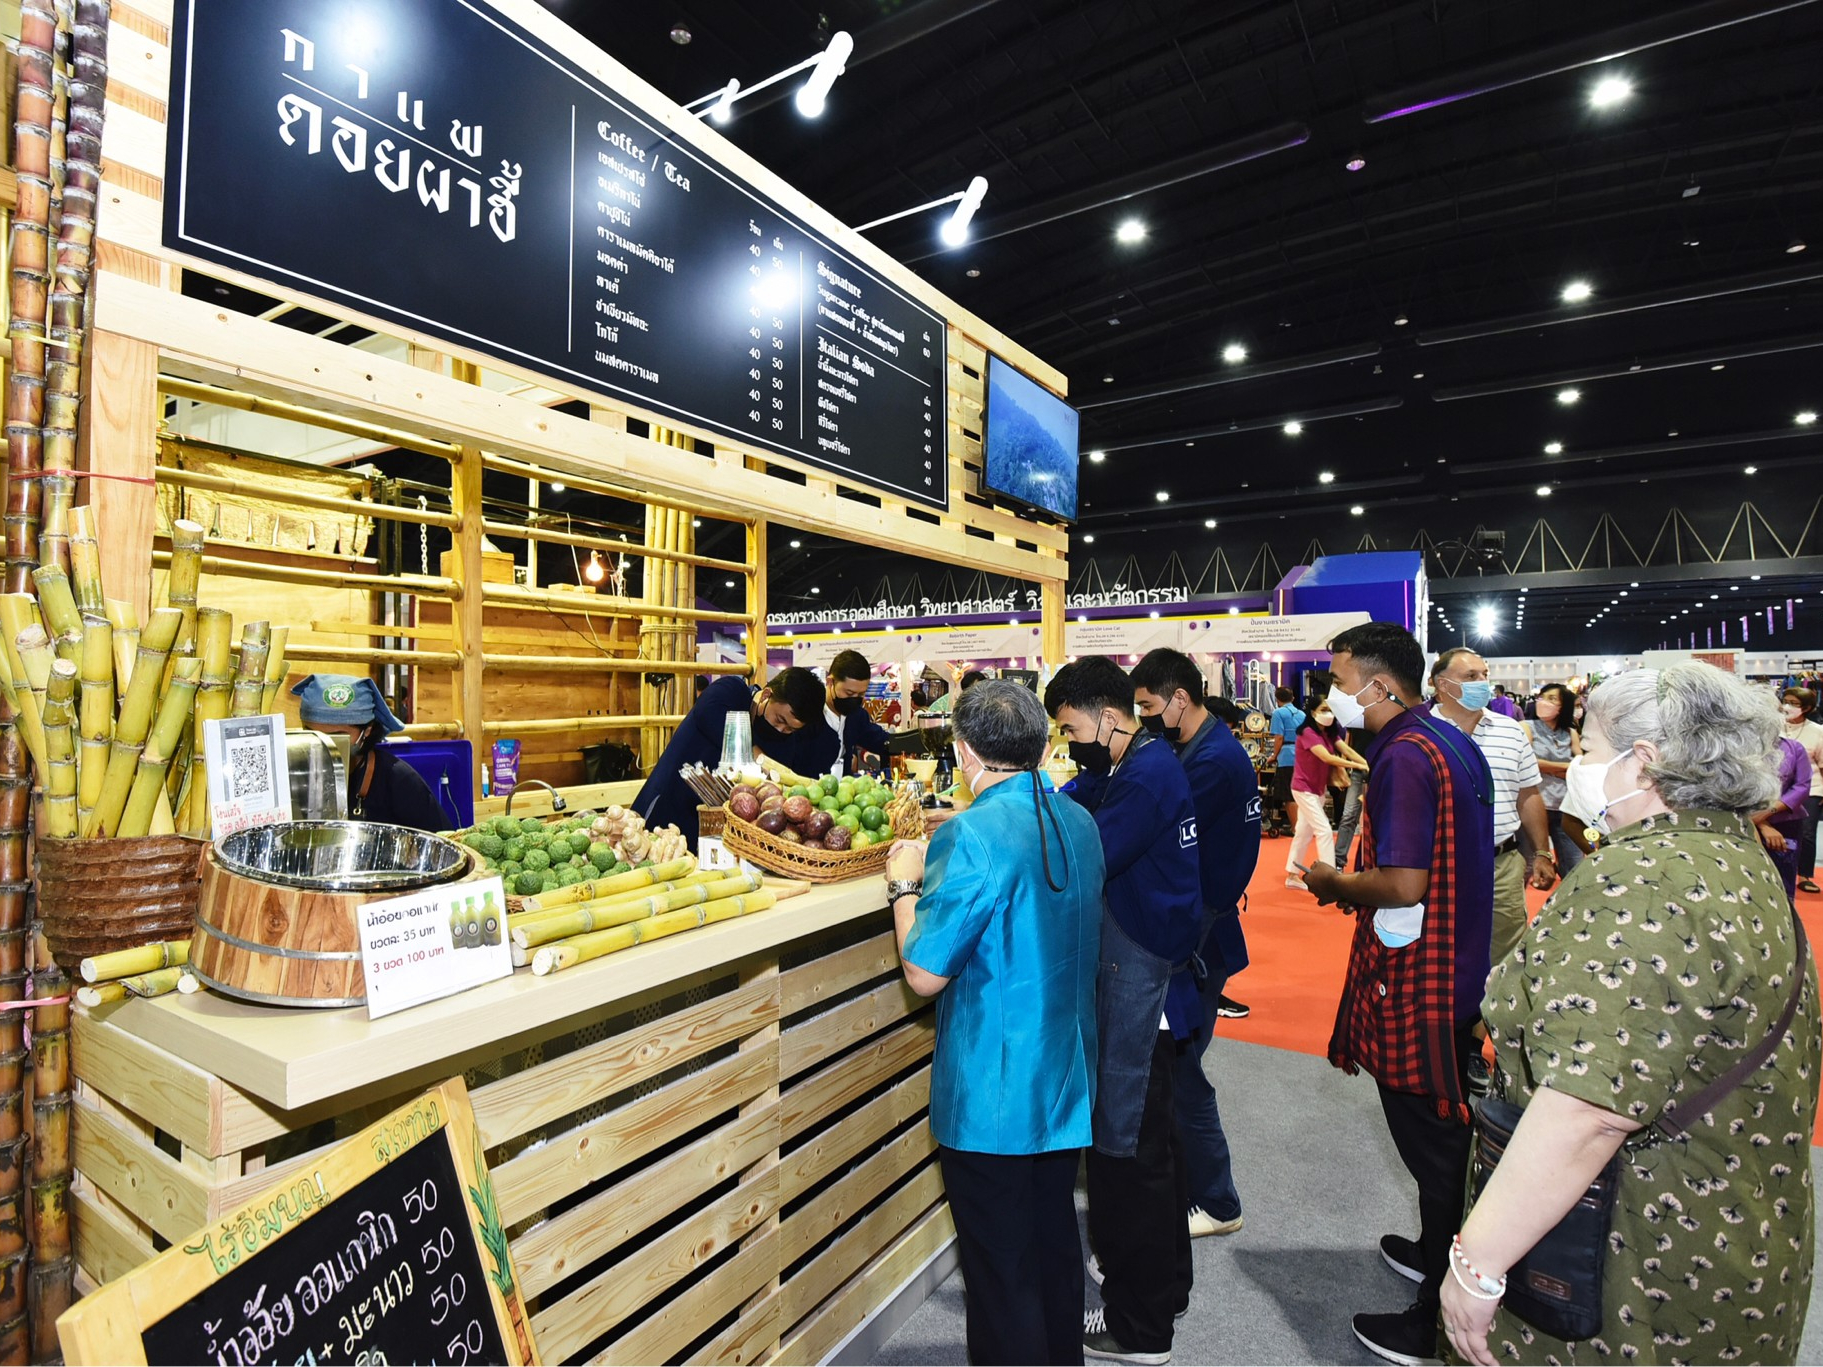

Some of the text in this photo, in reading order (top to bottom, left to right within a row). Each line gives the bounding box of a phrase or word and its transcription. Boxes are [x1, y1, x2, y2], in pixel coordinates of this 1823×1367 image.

[597, 120, 646, 163] Coffee
[664, 160, 691, 193] Tea
[749, 244, 783, 270] 40 50
[749, 264, 761, 277] 40
[817, 260, 862, 299] Signature
[596, 275, 620, 295] ลาเต้
[749, 306, 783, 330] 40 50
[850, 303, 871, 324] Coffee
[595, 322, 619, 343] โกโก้
[749, 327, 783, 350] 40 50
[749, 347, 783, 371] 40 50
[817, 336, 875, 378] Italian Soda
[749, 368, 783, 390] 40 50
[749, 389, 783, 411] 40 50
[749, 410, 783, 431] 40 50
[924, 412, 932, 422] 40
[924, 428, 932, 438] 40
[924, 444, 932, 454] 40
[924, 460, 932, 470] 40
[924, 476, 932, 486] 40
[920, 590, 1019, 618] วิทยาศาสตร์
[403, 929, 416, 941] 35
[419, 925, 436, 938] บาท
[373, 946, 445, 974] 3 ขวด 100 บาท
[402, 1179, 438, 1223] 50
[338, 1261, 414, 1356] มะนาว
[421, 1227, 455, 1275] 50
[430, 1272, 467, 1326] 50
[447, 1319, 484, 1367] 50
